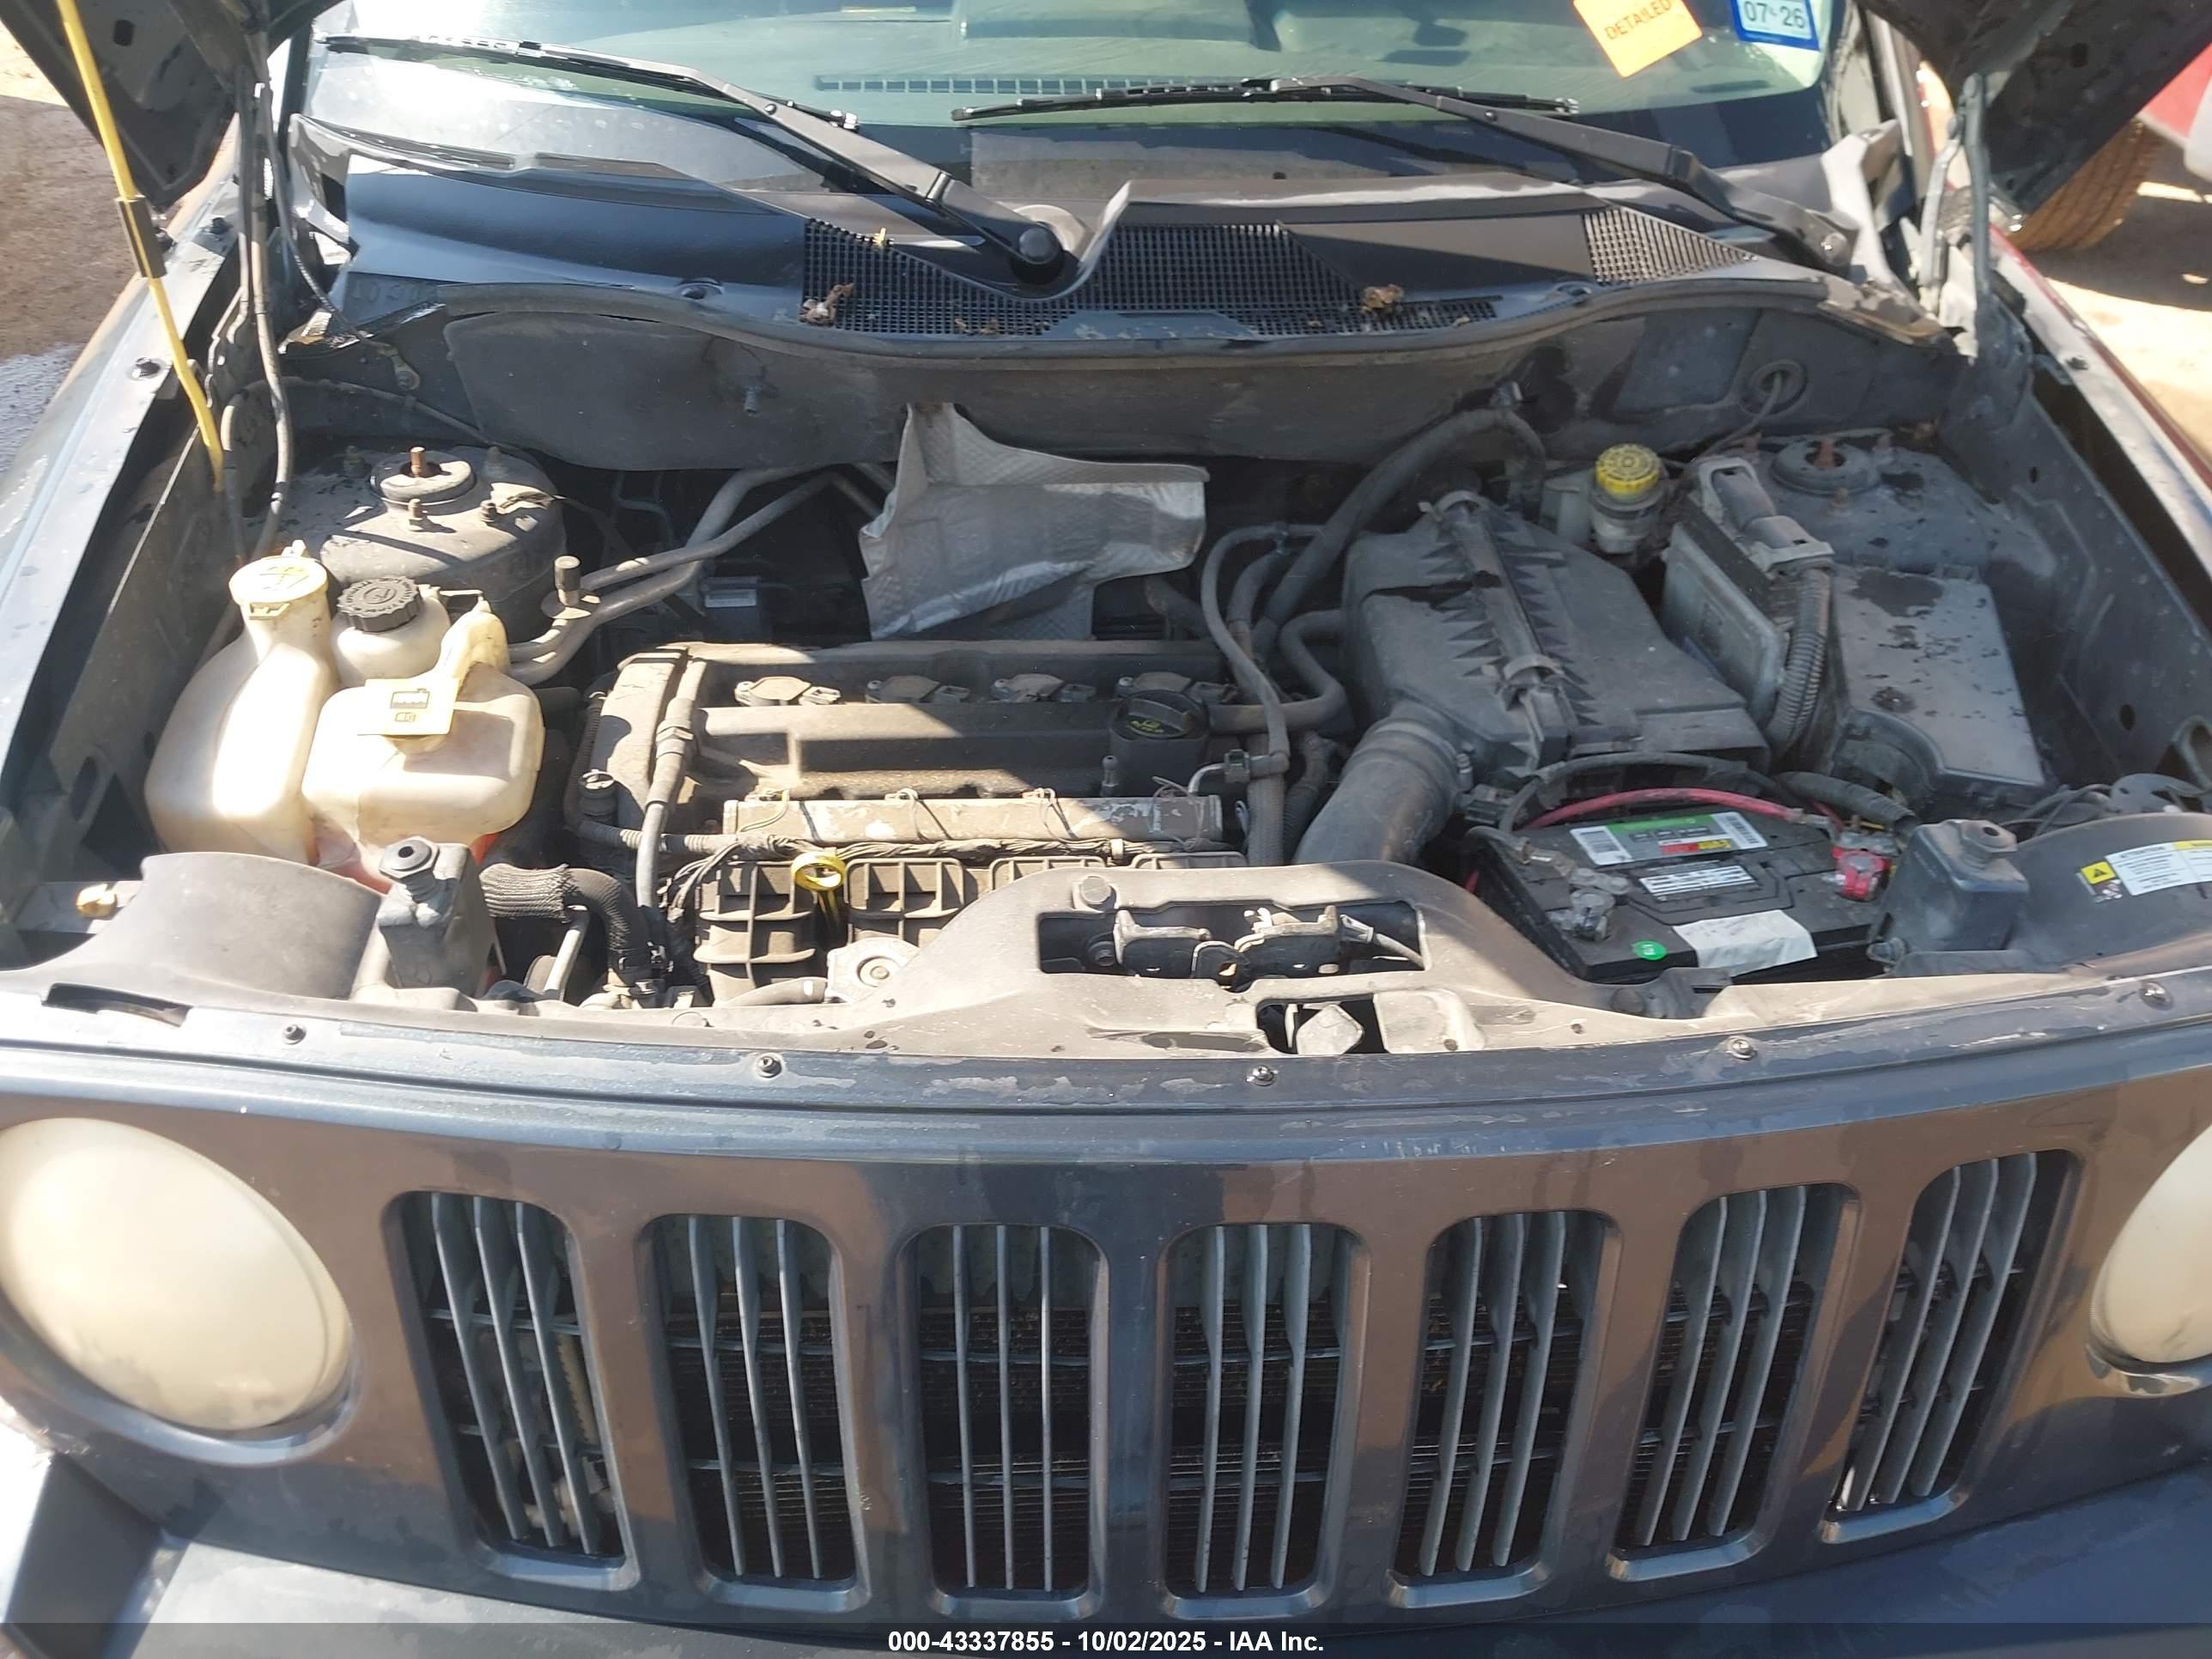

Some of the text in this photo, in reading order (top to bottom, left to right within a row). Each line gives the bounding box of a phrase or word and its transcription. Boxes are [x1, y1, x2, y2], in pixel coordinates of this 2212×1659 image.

[1604, 0, 1672, 40] DETAILED
[1744, 1, 1805, 29] 07 26
